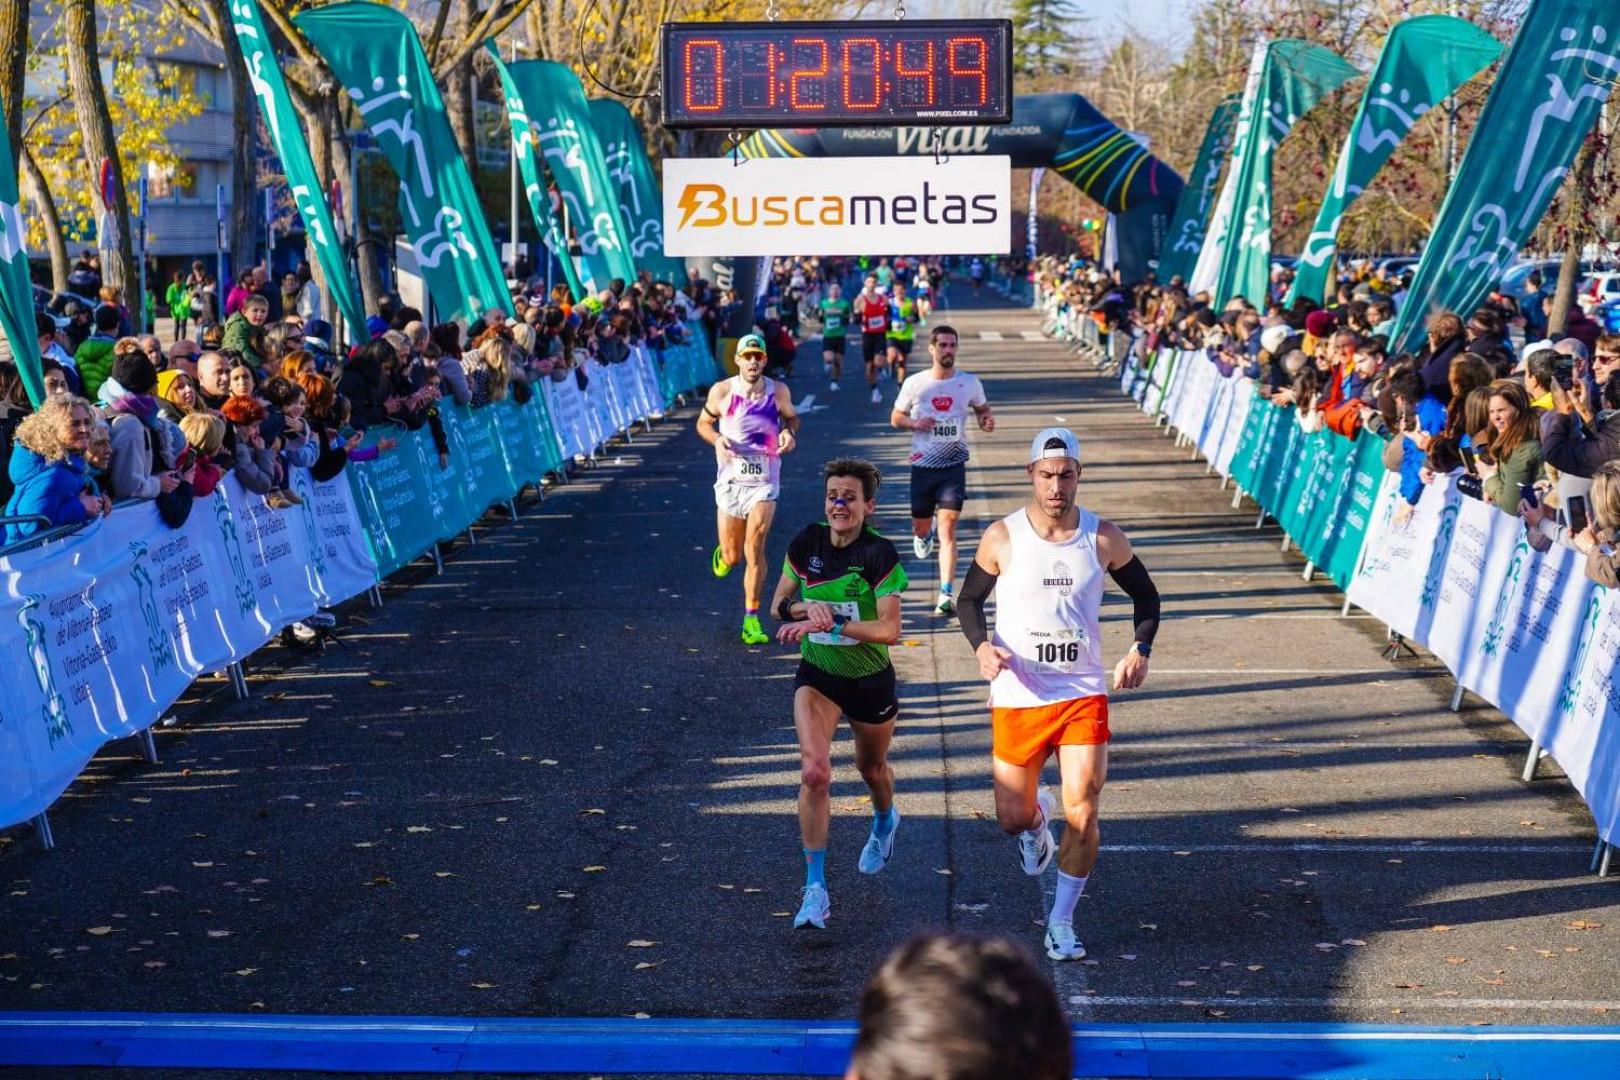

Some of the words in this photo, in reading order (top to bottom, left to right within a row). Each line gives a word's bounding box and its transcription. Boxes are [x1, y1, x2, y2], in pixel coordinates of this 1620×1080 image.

[683, 36, 987, 112] 01:20:49
[916, 110, 979, 118] WWW.PIXELCOM.ES
[677, 181, 998, 233] Buscametas
[933, 425, 958, 437] 1408
[740, 462, 762, 475] 365
[1035, 642, 1079, 663] 1016
